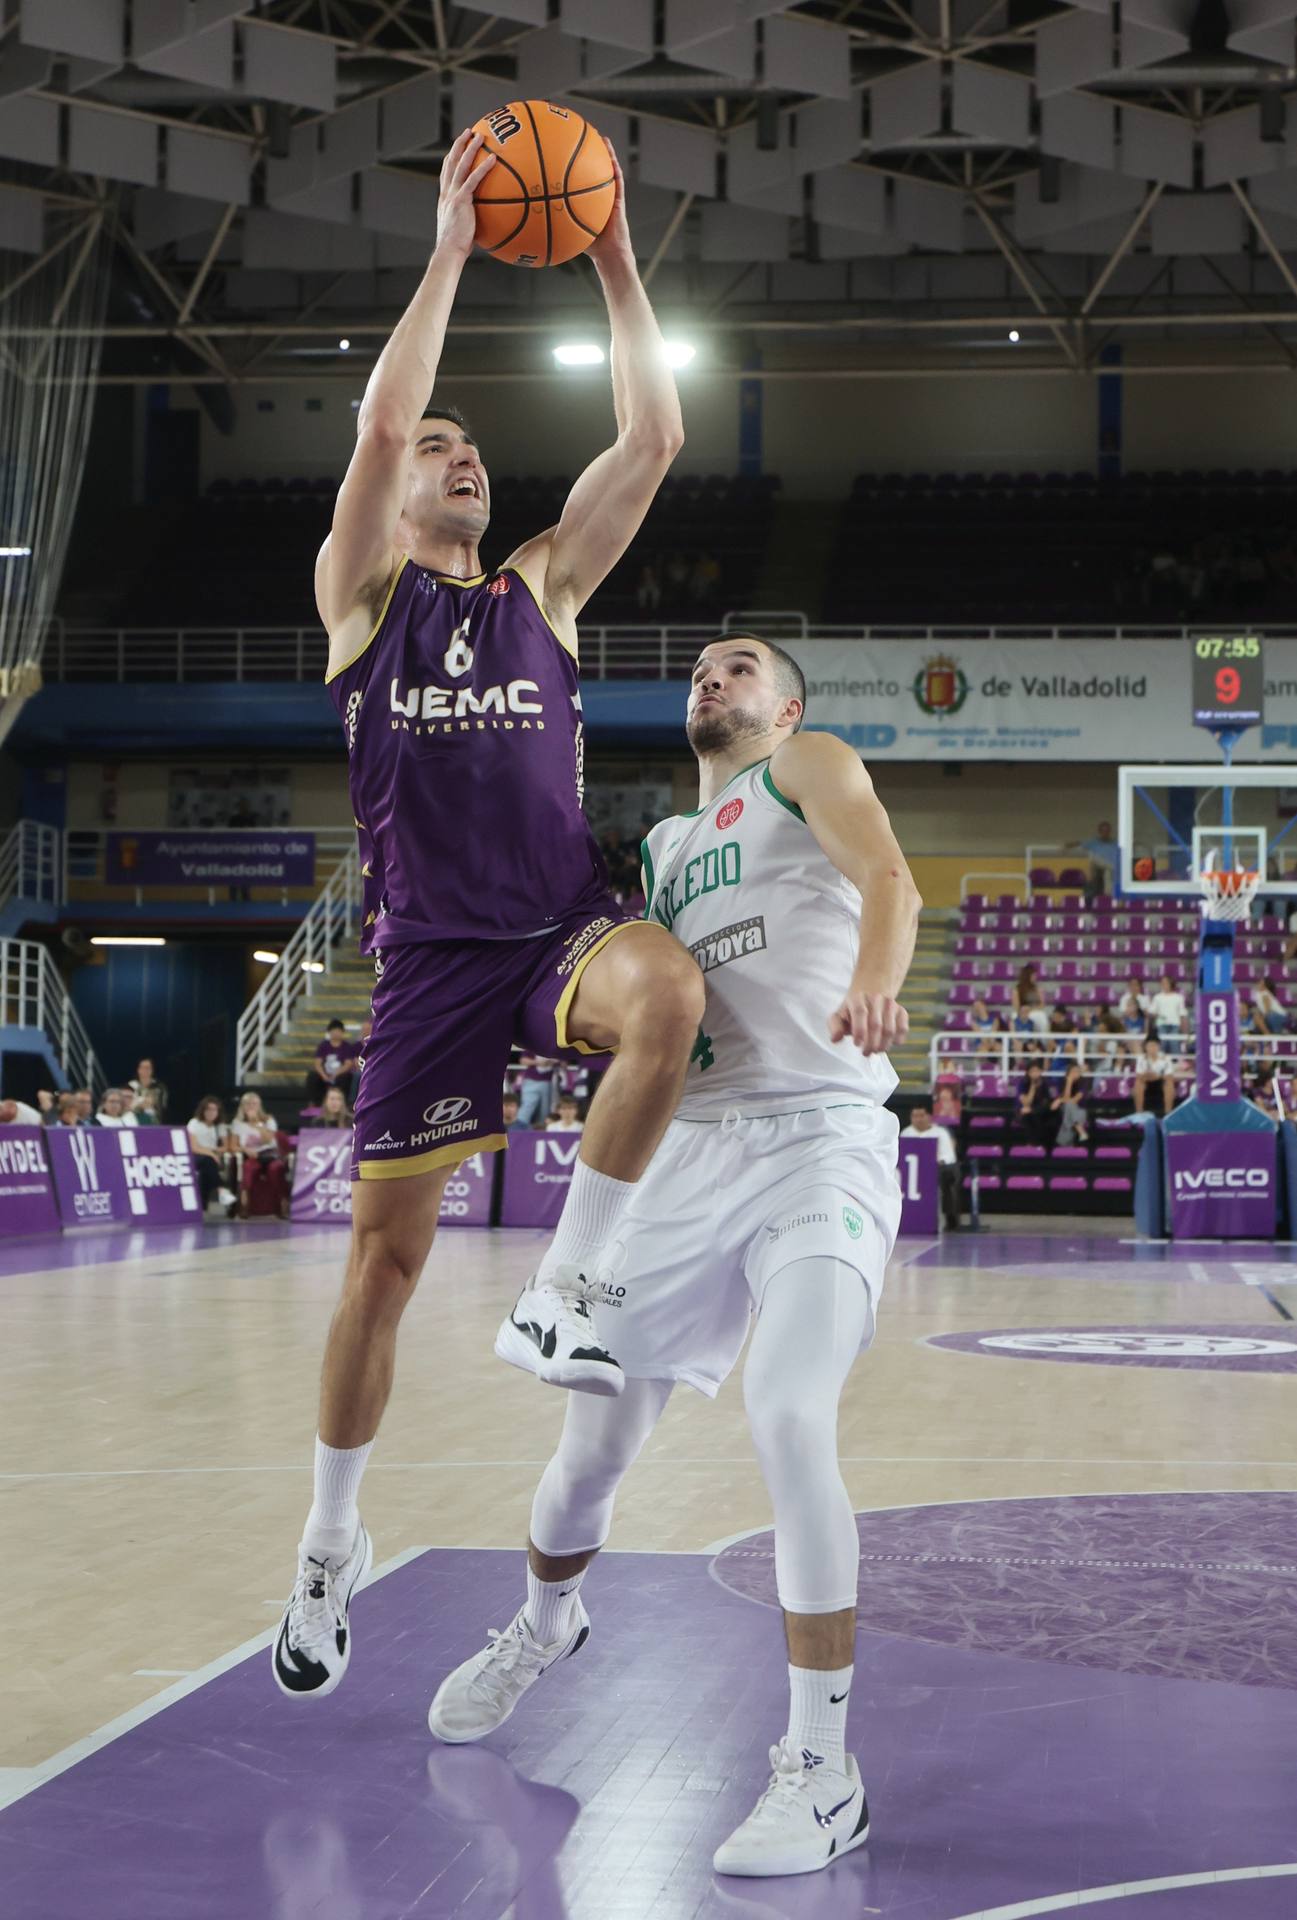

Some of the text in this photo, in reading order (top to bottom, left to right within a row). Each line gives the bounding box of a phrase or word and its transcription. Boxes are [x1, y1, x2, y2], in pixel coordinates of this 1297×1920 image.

[444, 617, 473, 677] 6
[1195, 638, 1260, 658] 07:55
[981, 675, 1011, 698] de
[1022, 676, 1147, 698] Valladolid
[1215, 666, 1240, 704] 9
[390, 678, 543, 719] UEMC
[391, 720, 545, 736] UNIVERSIDAD
[157, 841, 307, 857] Ayuntamiento de
[181, 864, 284, 877] Valladolid
[1208, 999, 1228, 1096] IVECO
[410, 1118, 479, 1147] HYUNDAI
[363, 1140, 406, 1151] MERCURY
[122, 1155, 194, 1188] HORSE
[1174, 1168, 1269, 1189] IVECO
